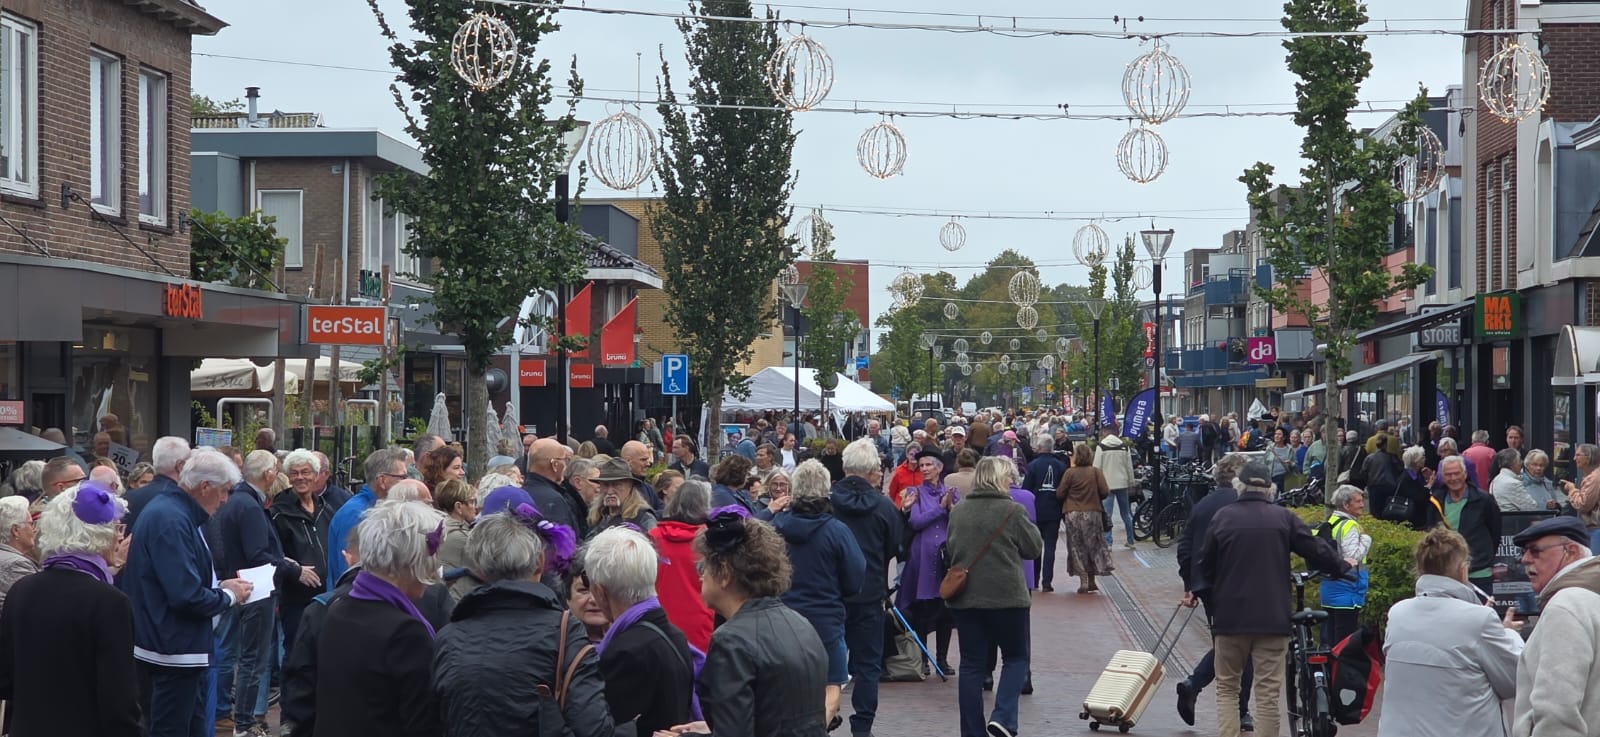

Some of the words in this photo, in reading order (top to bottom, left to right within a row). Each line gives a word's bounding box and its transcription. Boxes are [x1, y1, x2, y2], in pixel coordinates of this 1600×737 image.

[167, 282, 204, 320] terStal
[1484, 296, 1511, 313] MA
[312, 317, 381, 334] terStal
[1423, 329, 1458, 344] STORE
[1250, 341, 1273, 360] da
[667, 357, 682, 378] P
[0, 406, 17, 415] 0%
[1129, 400, 1147, 435] primera
